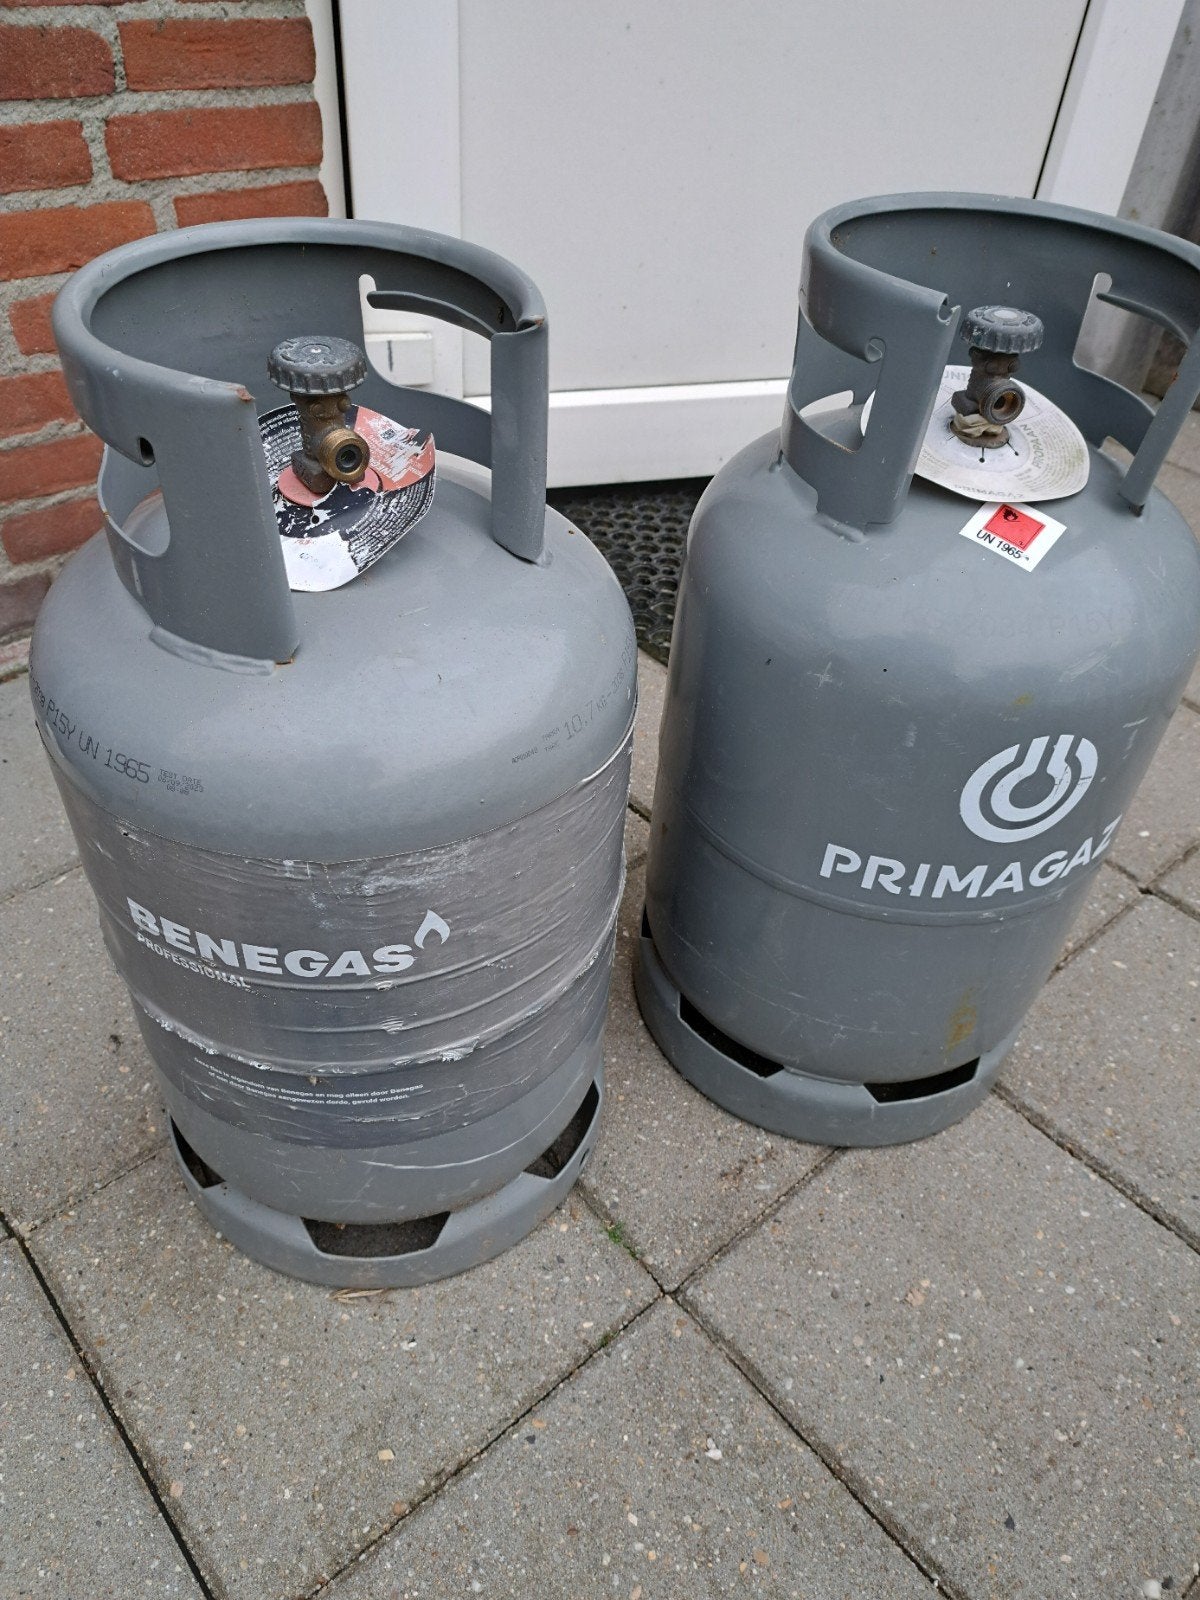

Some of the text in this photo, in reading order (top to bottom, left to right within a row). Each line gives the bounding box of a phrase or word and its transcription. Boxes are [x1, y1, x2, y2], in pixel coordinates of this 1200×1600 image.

[1020, 424, 1045, 469] PROPAAN
[976, 529, 1023, 560] UN 1965
[46, 699, 151, 784] P15Y UN 1965
[159, 768, 201, 786] TEST DATE
[820, 815, 1122, 899] PRIMAGAZ
[127, 897, 417, 977] BENEGAS
[136, 932, 251, 989] PROFESSIONAL
[230, 1075, 266, 1090] eigendom
[281, 1088, 314, 1098] Benegas
[370, 1089, 389, 1097] door
[389, 1083, 424, 1094] Benegas
[352, 1098, 378, 1106] gevuld
